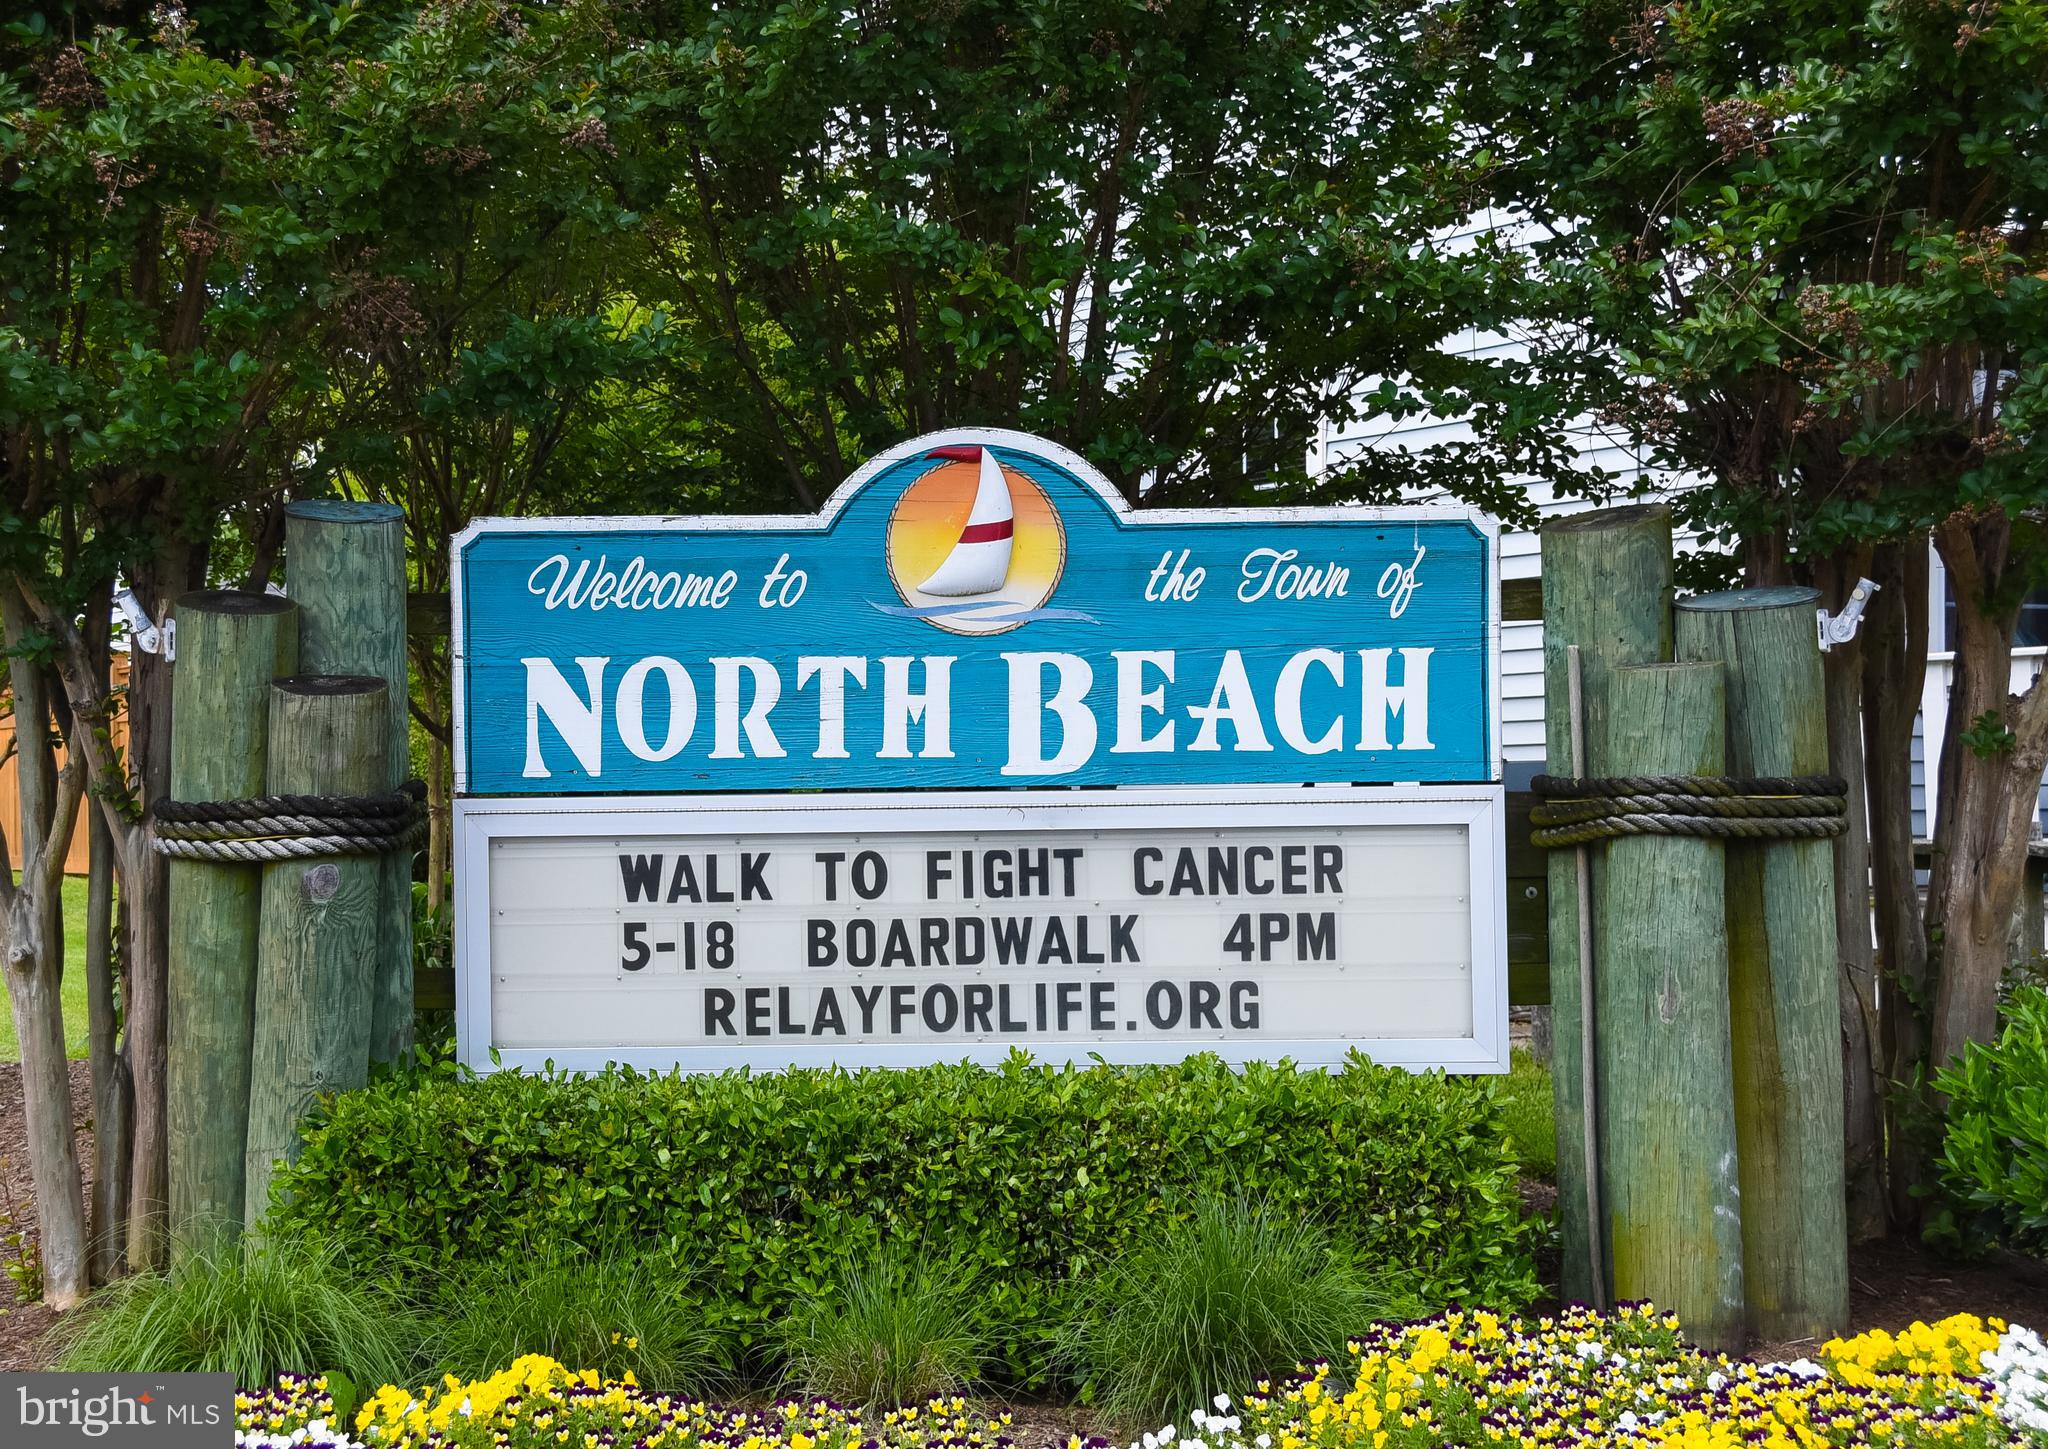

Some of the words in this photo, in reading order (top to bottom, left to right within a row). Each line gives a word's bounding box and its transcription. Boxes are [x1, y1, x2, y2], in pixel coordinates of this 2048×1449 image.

[527, 554, 738, 611] Welcome
[758, 553, 808, 609] to
[1144, 548, 1206, 602] the
[1237, 547, 1350, 603] Town
[1376, 545, 1426, 619] of
[521, 655, 958, 778] NORTH
[1000, 647, 1436, 776] BEACH
[618, 852, 773, 904] WALK
[815, 850, 888, 901] TO
[926, 847, 1084, 900] FIGHT
[1133, 845, 1343, 896] CANCER
[621, 921, 734, 972] 5-18
[807, 914, 1141, 968] BOARDWALK
[1223, 912, 1336, 962] 4PM
[704, 980, 1259, 1036] RELAYFORLIFE.ORG
